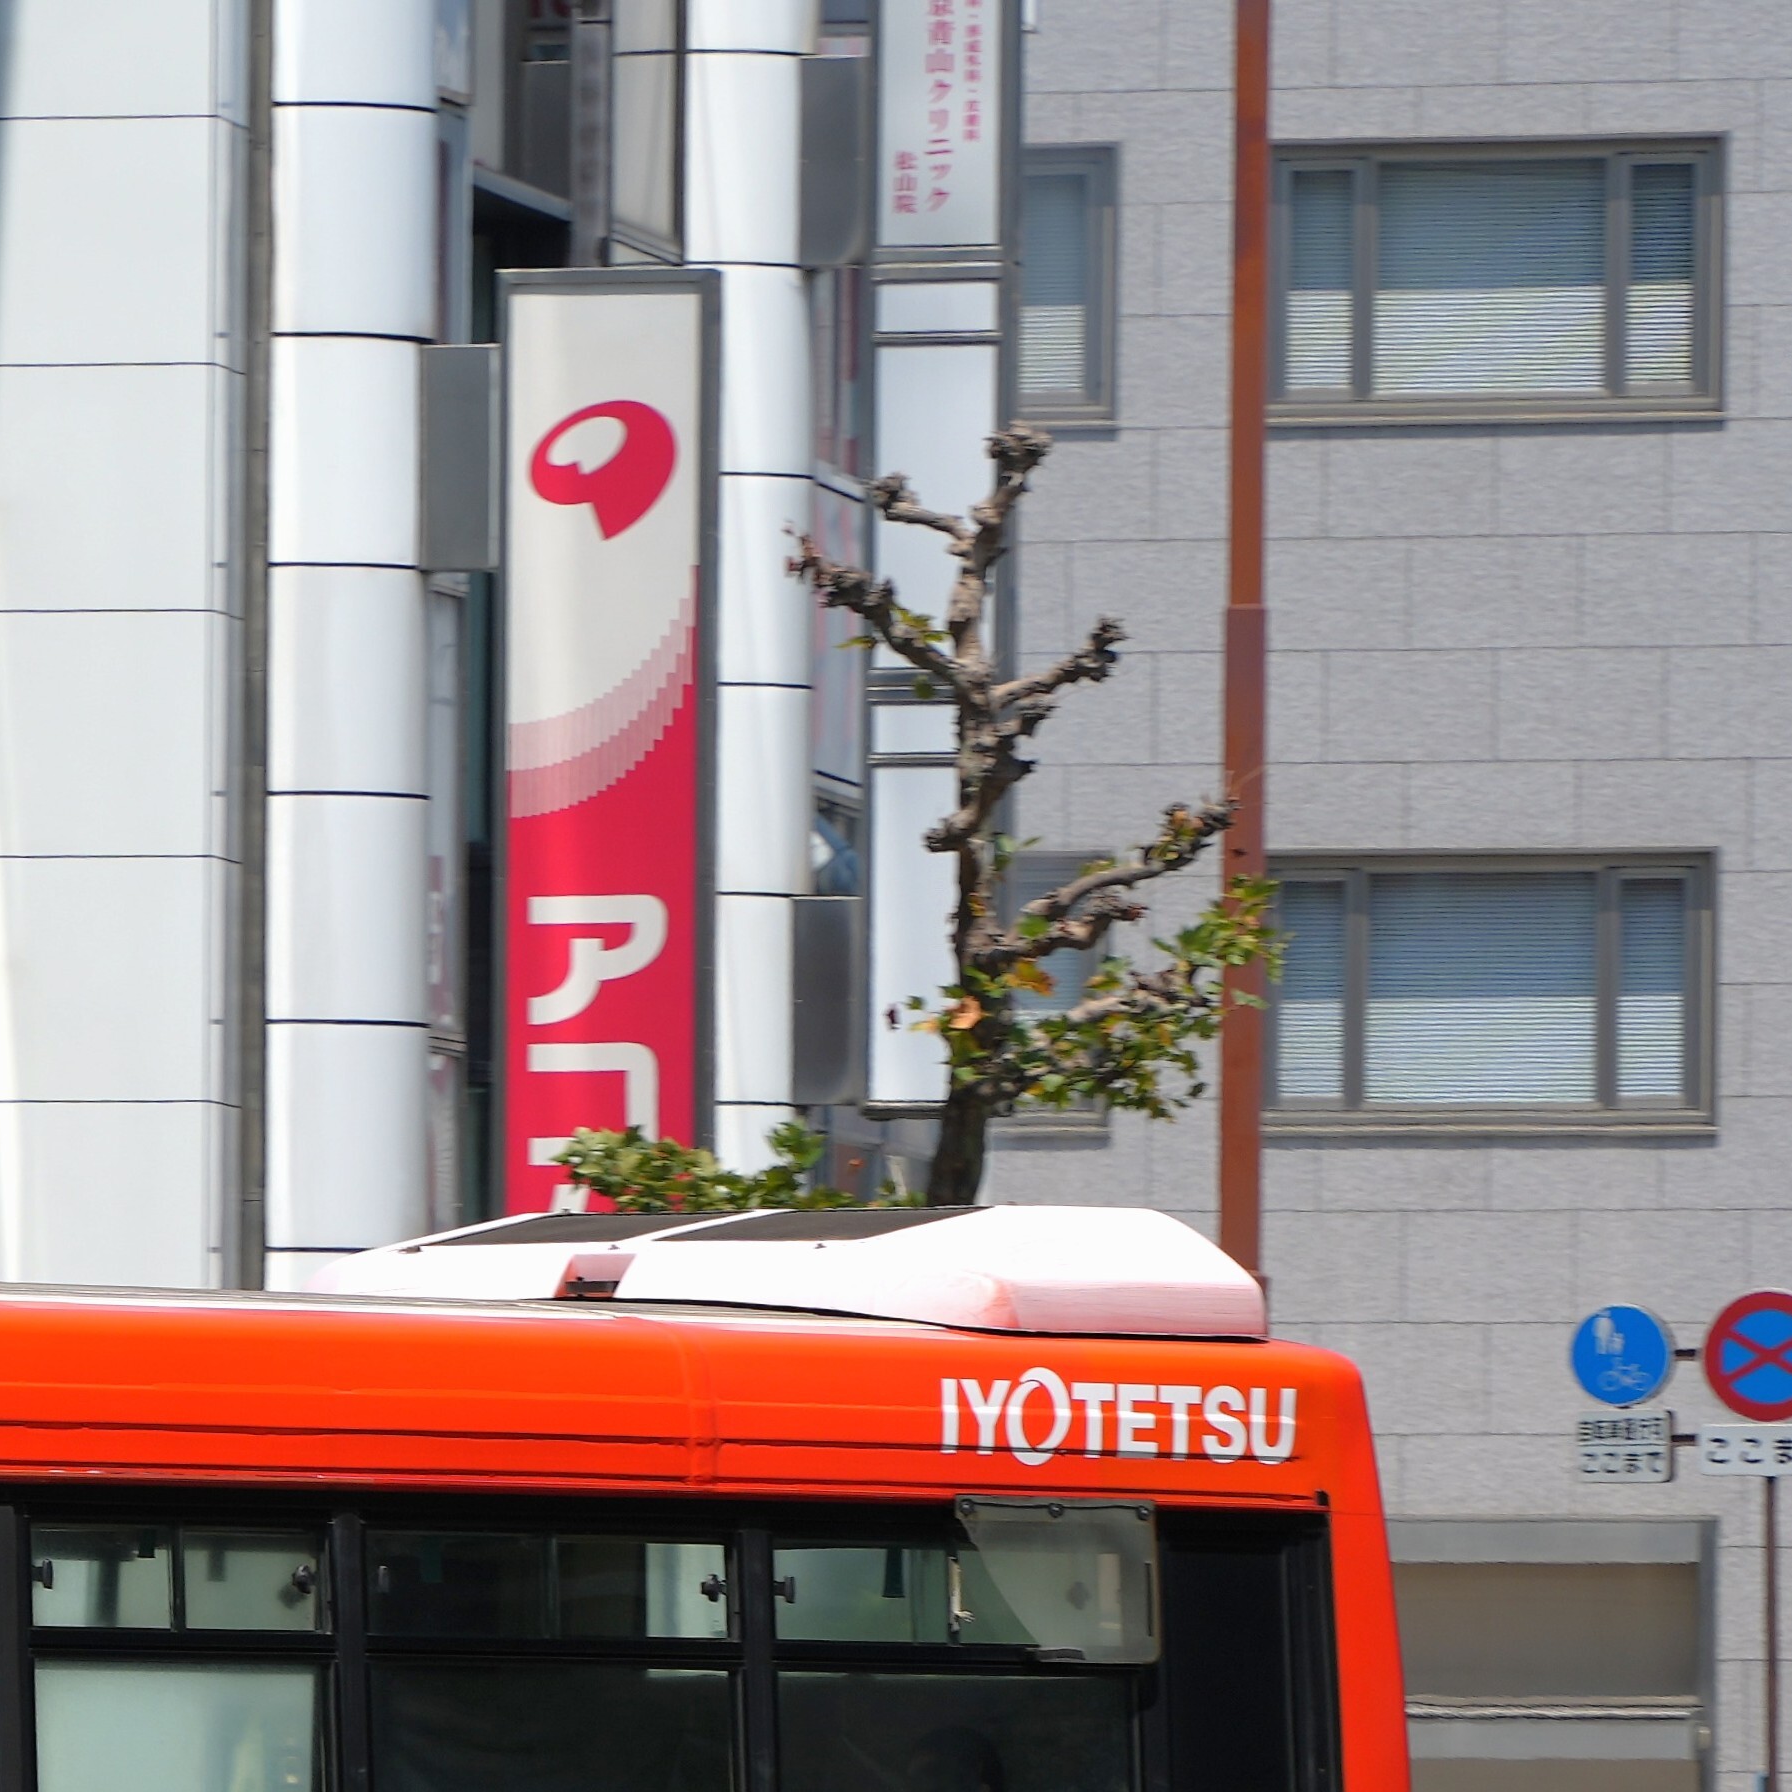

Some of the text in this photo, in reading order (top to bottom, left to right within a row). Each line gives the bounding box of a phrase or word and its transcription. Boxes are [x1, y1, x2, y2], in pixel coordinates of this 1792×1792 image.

[527, 895, 667, 1213] アコ
[940, 1366, 1297, 1466] IYOTETSU
[1581, 1452, 1663, 1473] ここまで
